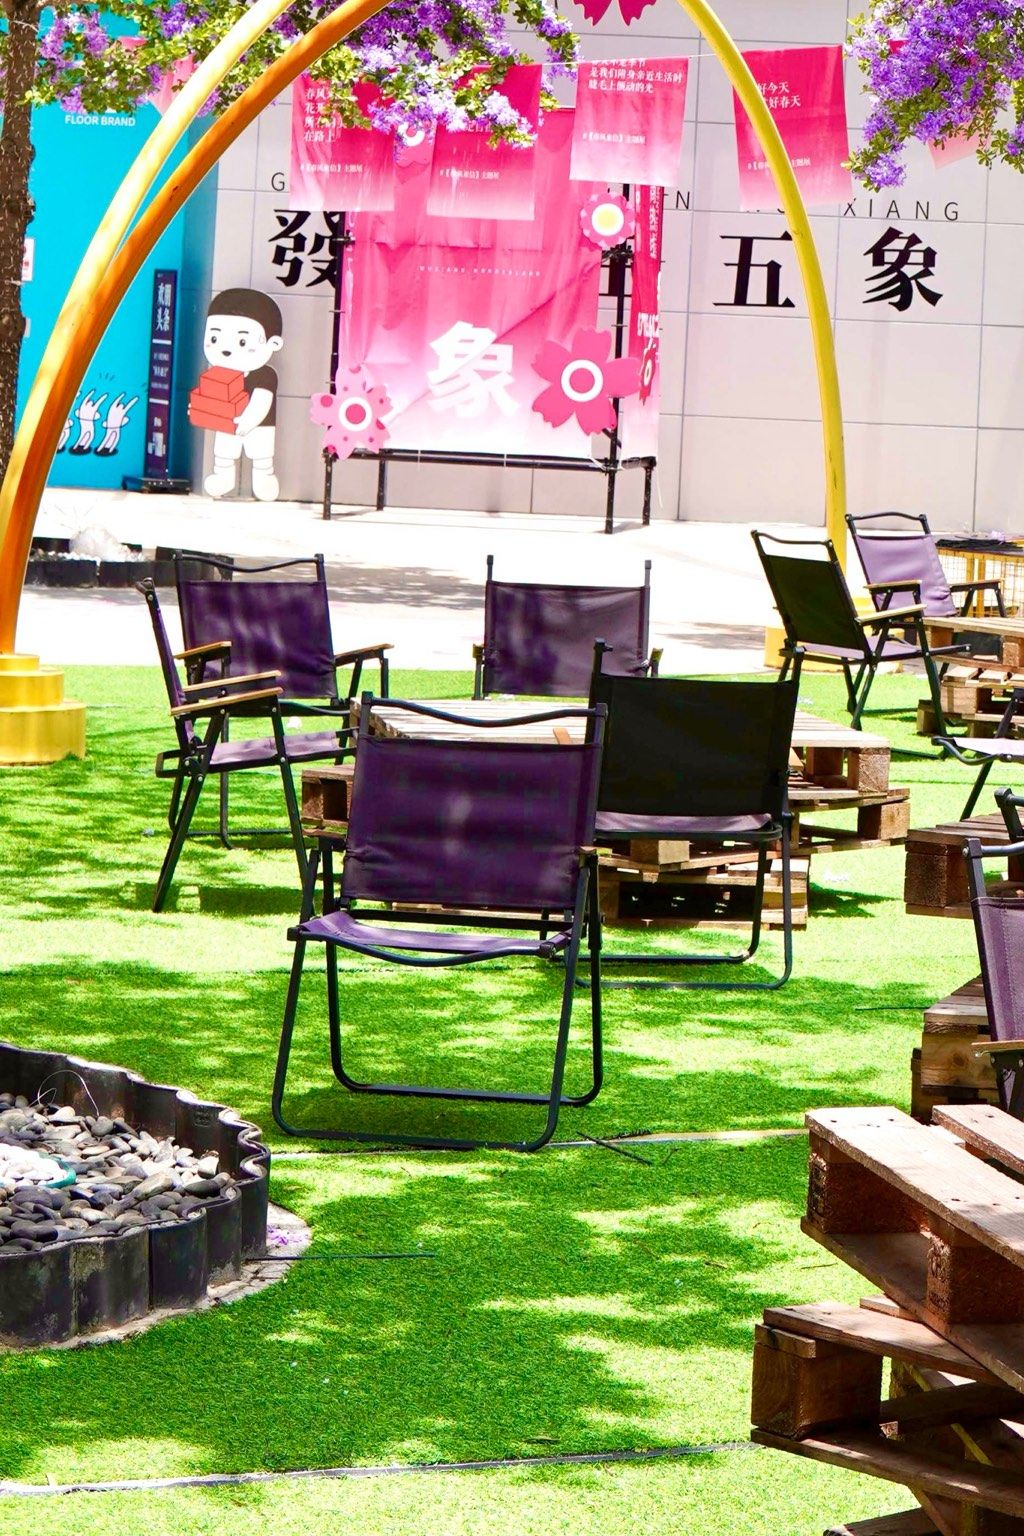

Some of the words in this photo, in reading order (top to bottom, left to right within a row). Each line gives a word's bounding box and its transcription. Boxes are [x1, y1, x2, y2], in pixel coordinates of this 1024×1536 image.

[64, 115, 99, 126] FLOOR
[100, 116, 136, 127] BRAND
[426, 320, 520, 418] 象
